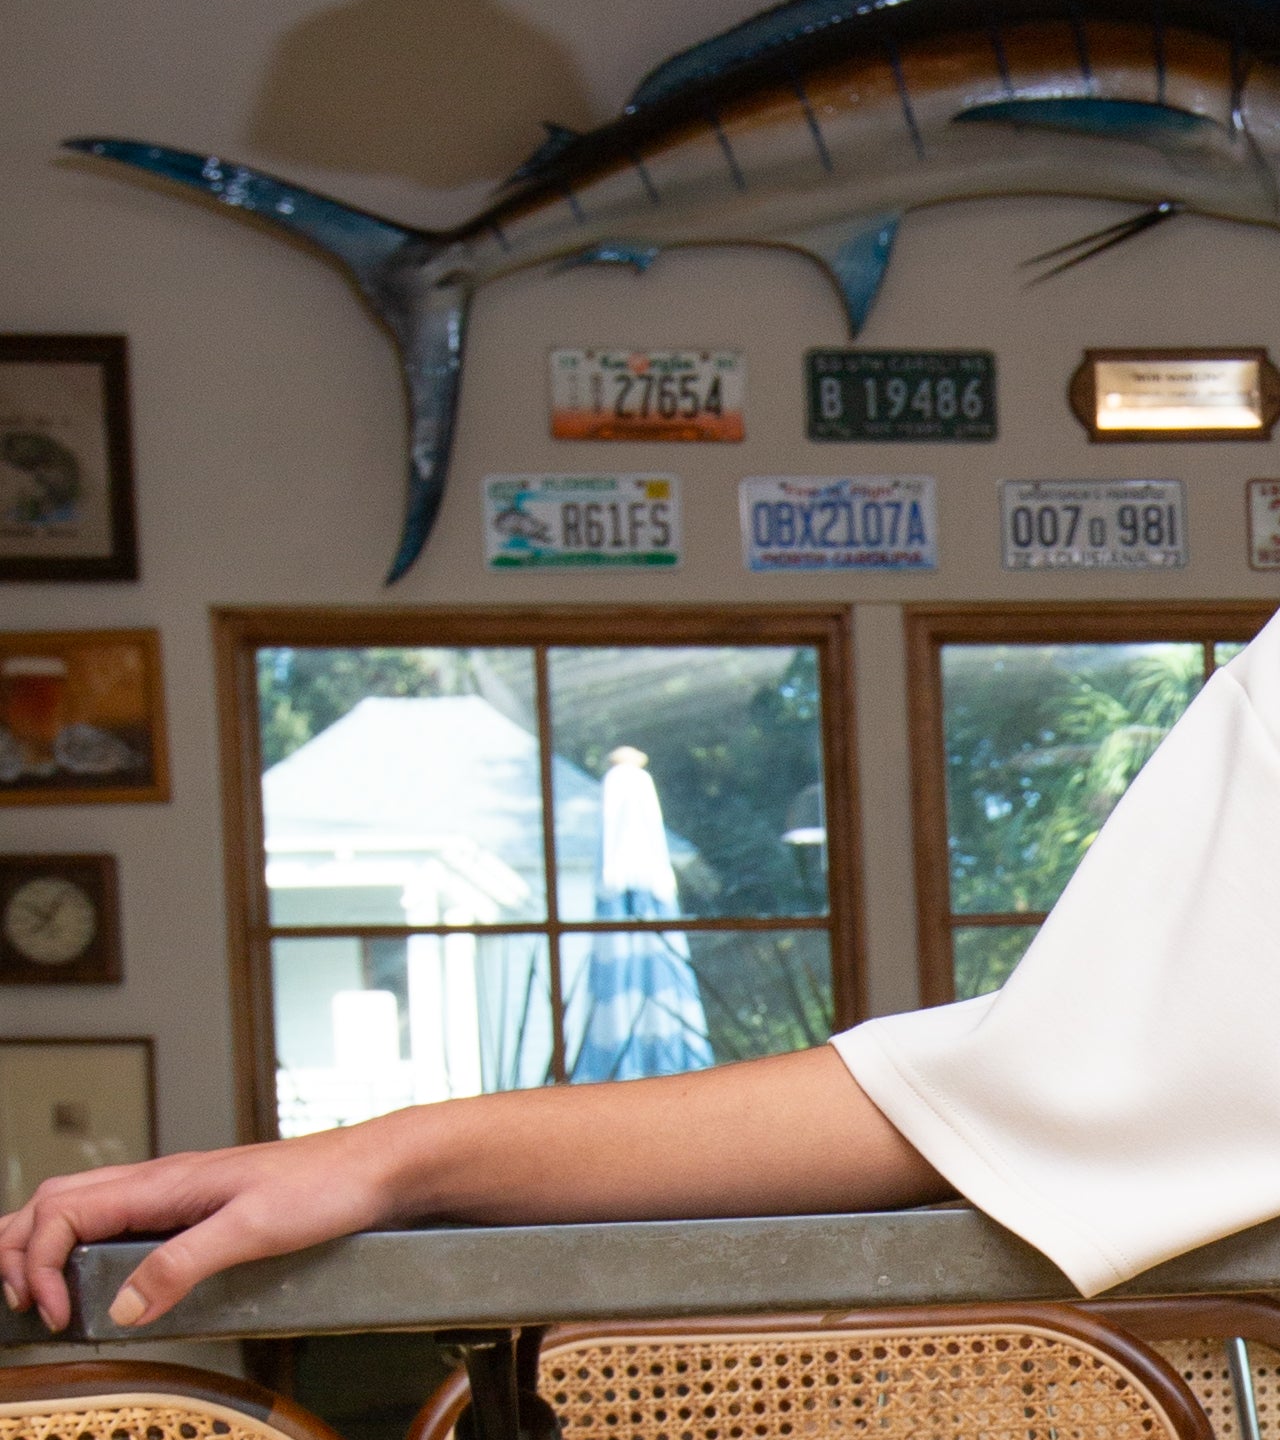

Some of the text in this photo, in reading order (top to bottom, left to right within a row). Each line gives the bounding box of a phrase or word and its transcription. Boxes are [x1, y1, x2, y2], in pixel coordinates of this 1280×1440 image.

[614, 374, 722, 419] 27654
[819, 377, 984, 419] B 19486
[1012, 505, 1081, 548] 007
